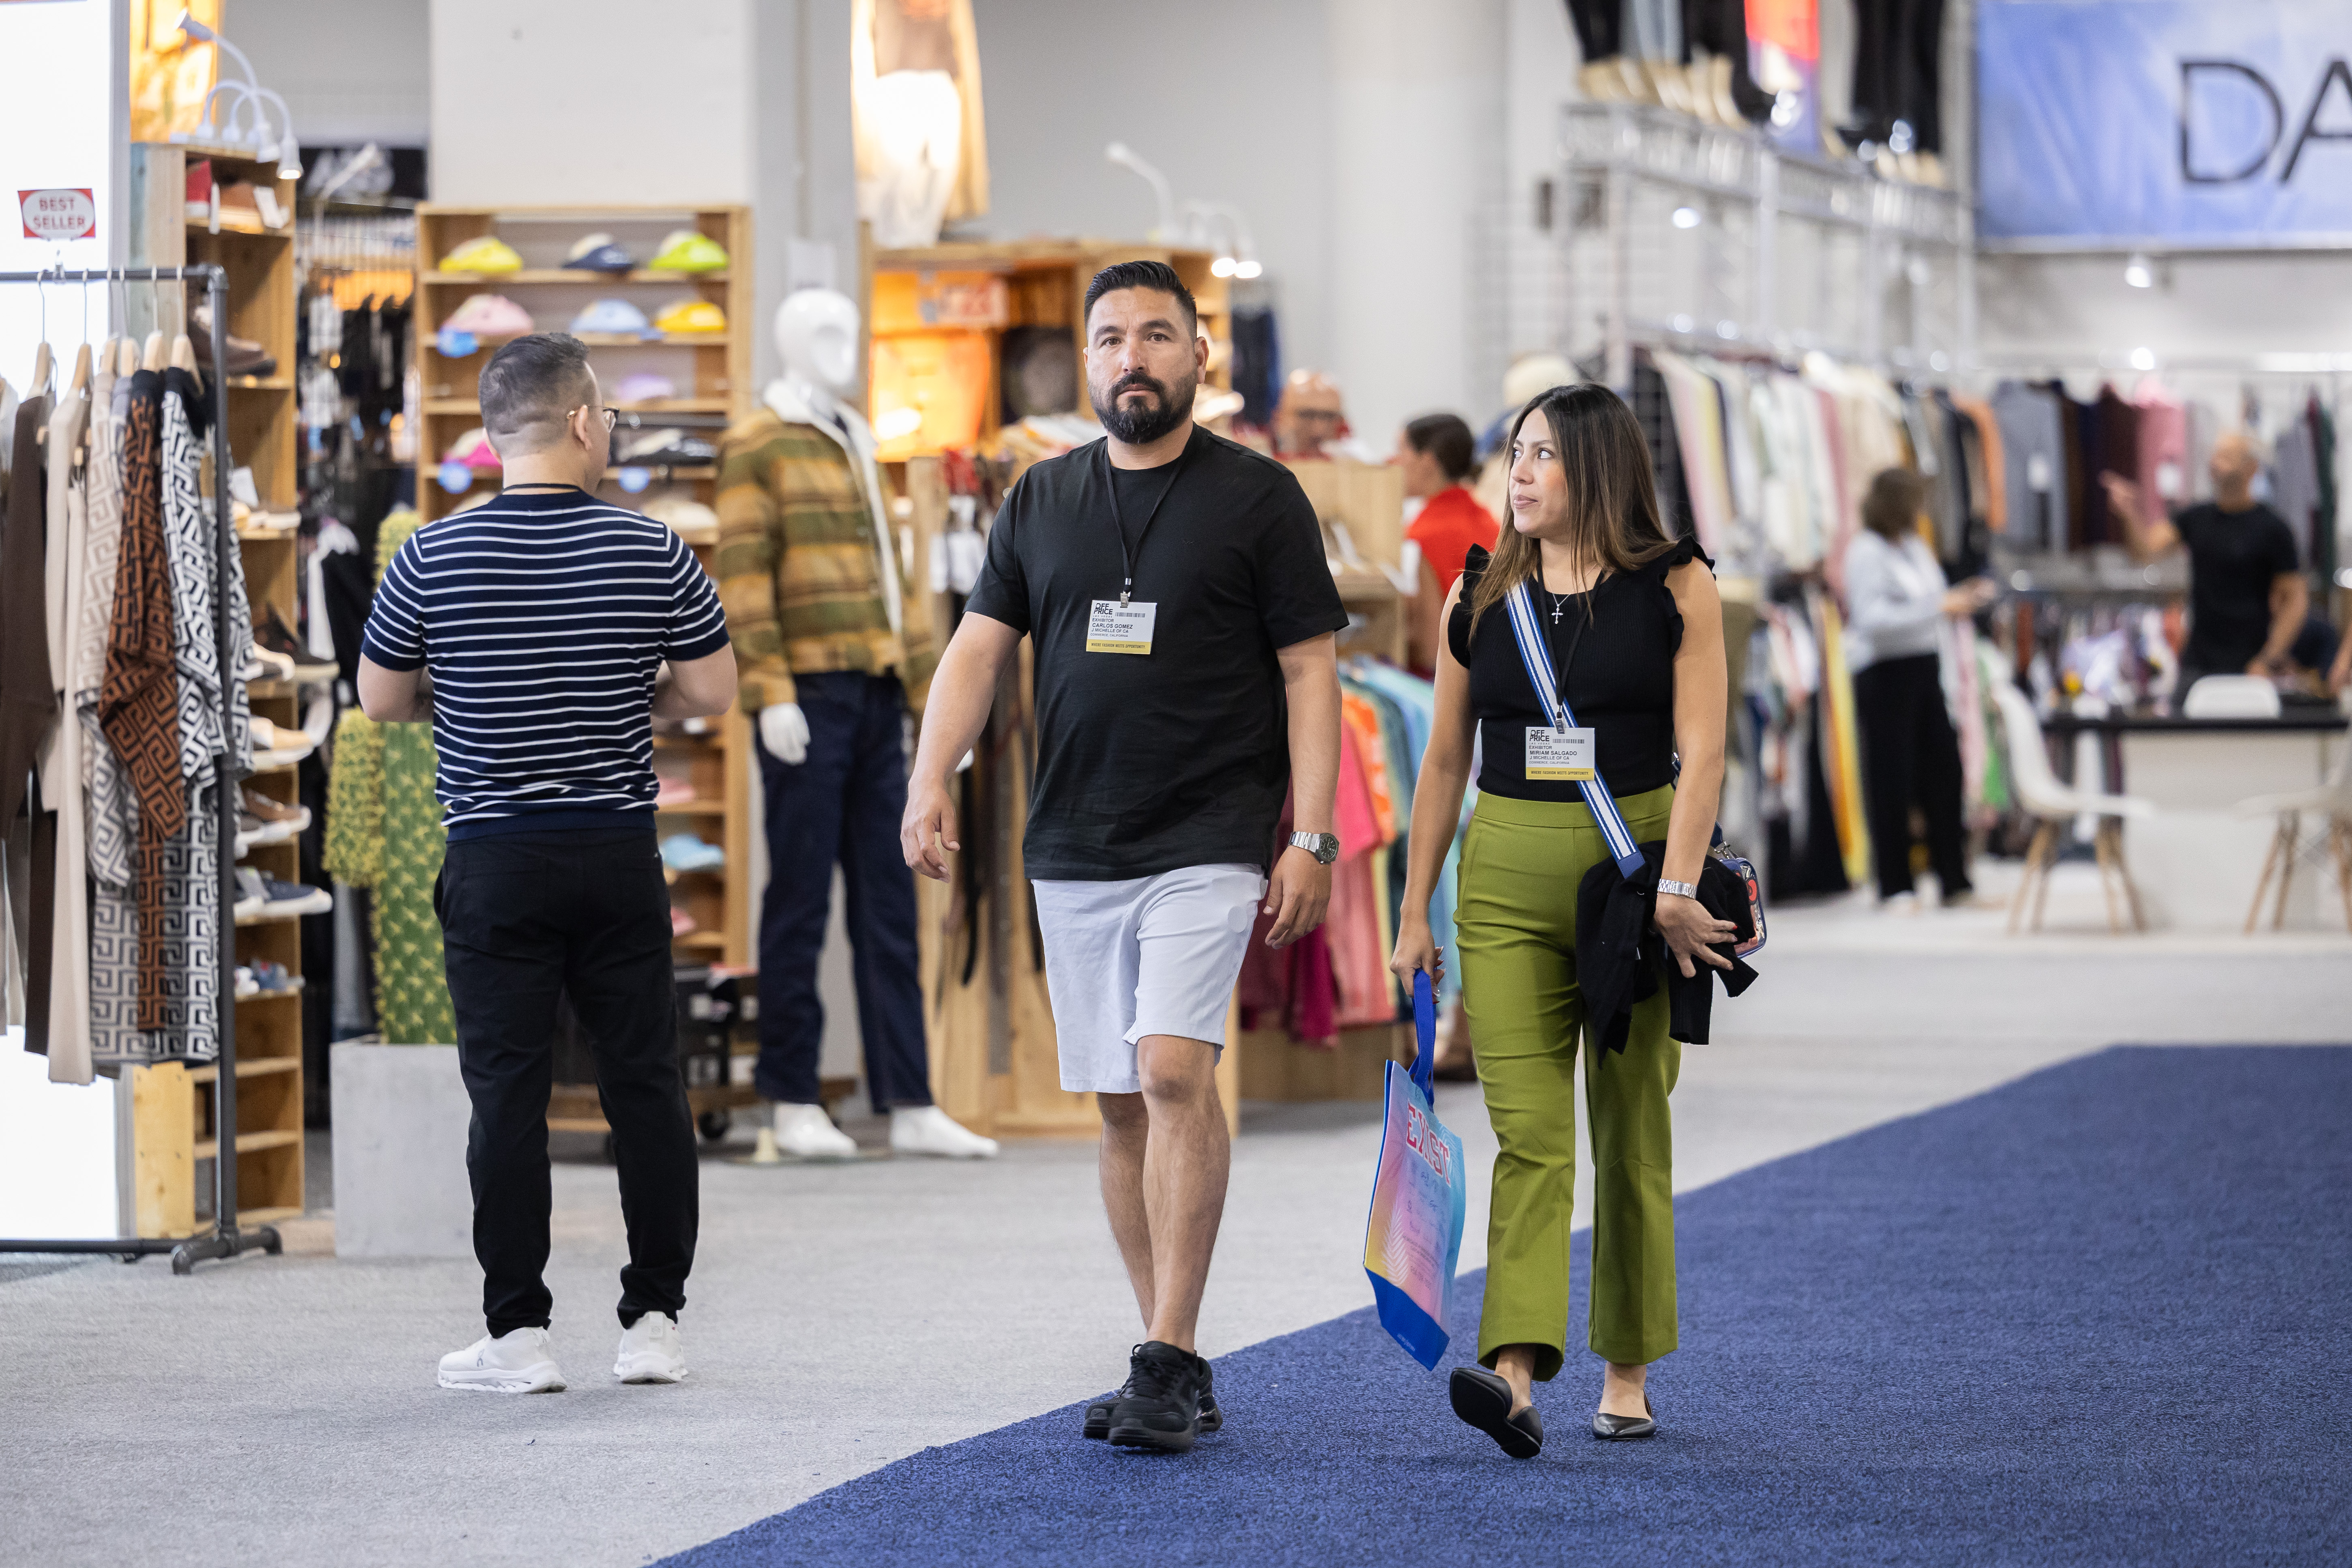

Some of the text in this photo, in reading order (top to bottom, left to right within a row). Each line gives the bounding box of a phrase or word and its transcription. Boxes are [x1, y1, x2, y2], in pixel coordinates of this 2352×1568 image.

[39, 196, 75, 211] BEST
[33, 215, 85, 230] SELLER
[1406, 1098, 1451, 1188] EXIST
